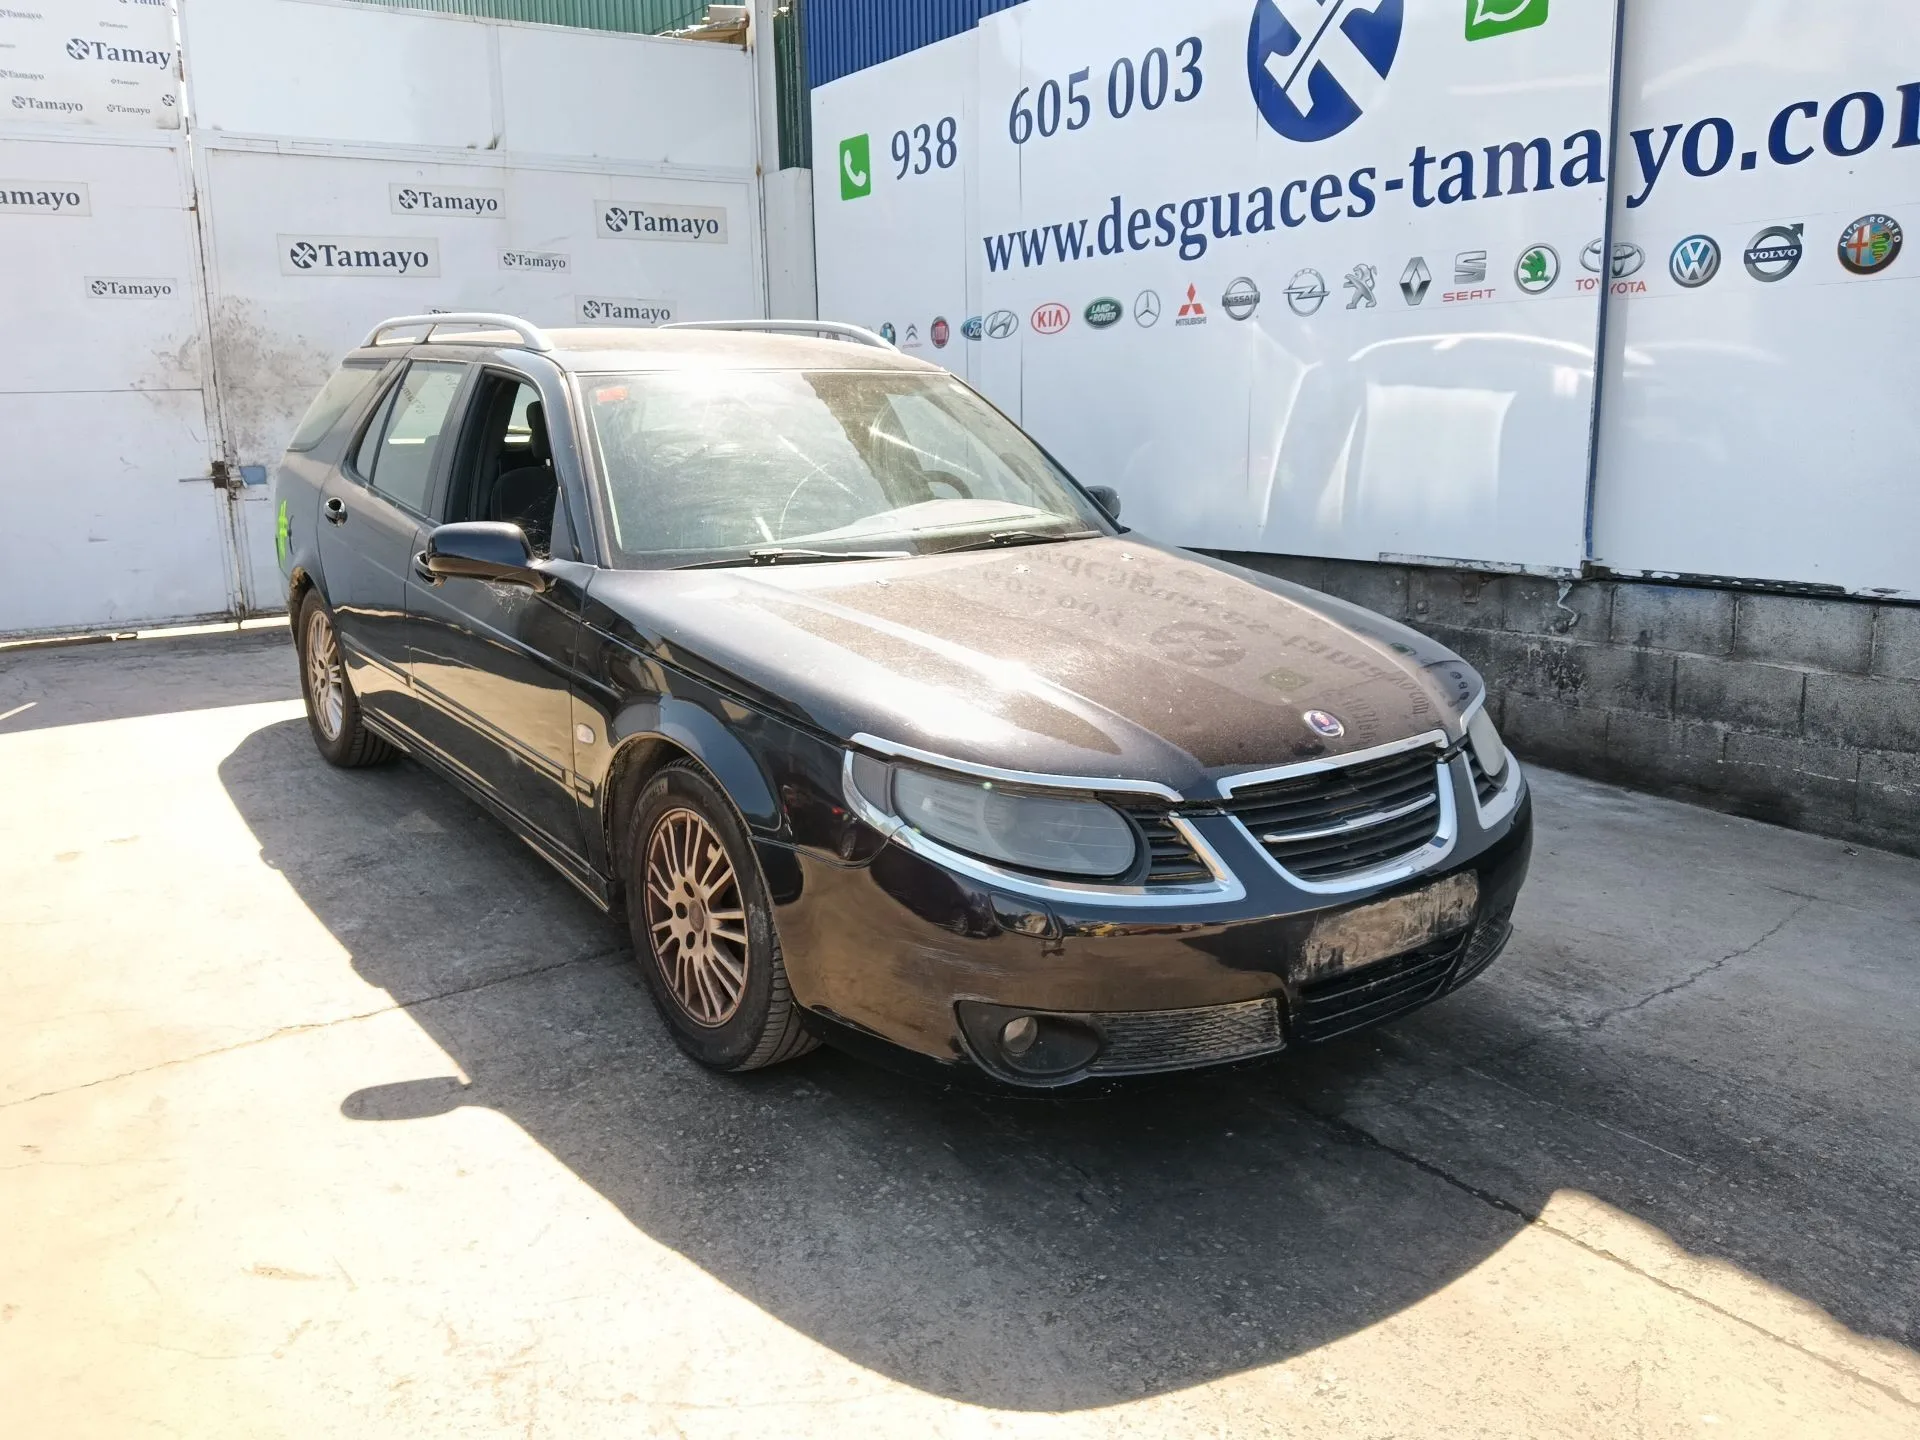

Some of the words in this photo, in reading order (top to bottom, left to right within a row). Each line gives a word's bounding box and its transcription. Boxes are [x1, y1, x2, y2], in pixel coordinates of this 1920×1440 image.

[90, 41, 171, 70] Tamay
[8, 70, 45, 81] Tamayo
[26, 97, 84, 114] Tamayo
[115, 104, 151, 115] Tamayo
[891, 116, 958, 180] 938
[1009, 66, 1091, 146] 605
[1108, 37, 1203, 119] 003
[0, 190, 81, 211] amayo
[419, 191, 498, 214] Tamayo
[629, 210, 719, 239] Tamayo
[1840, 223, 1860, 248] ALFA
[1869, 216, 1901, 243] ROMEO
[319, 244, 429, 274] Tamayo
[515, 254, 566, 270] Tamayo
[1748, 248, 1798, 260] VOLVO
[107, 281, 172, 298] Tamayo
[1442, 288, 1496, 302] SEAT
[600, 302, 671, 323] Tamayo
[1091, 303, 1112, 314] LAND
[1091, 311, 1117, 322] ROVER
[1037, 309, 1063, 328] KIA
